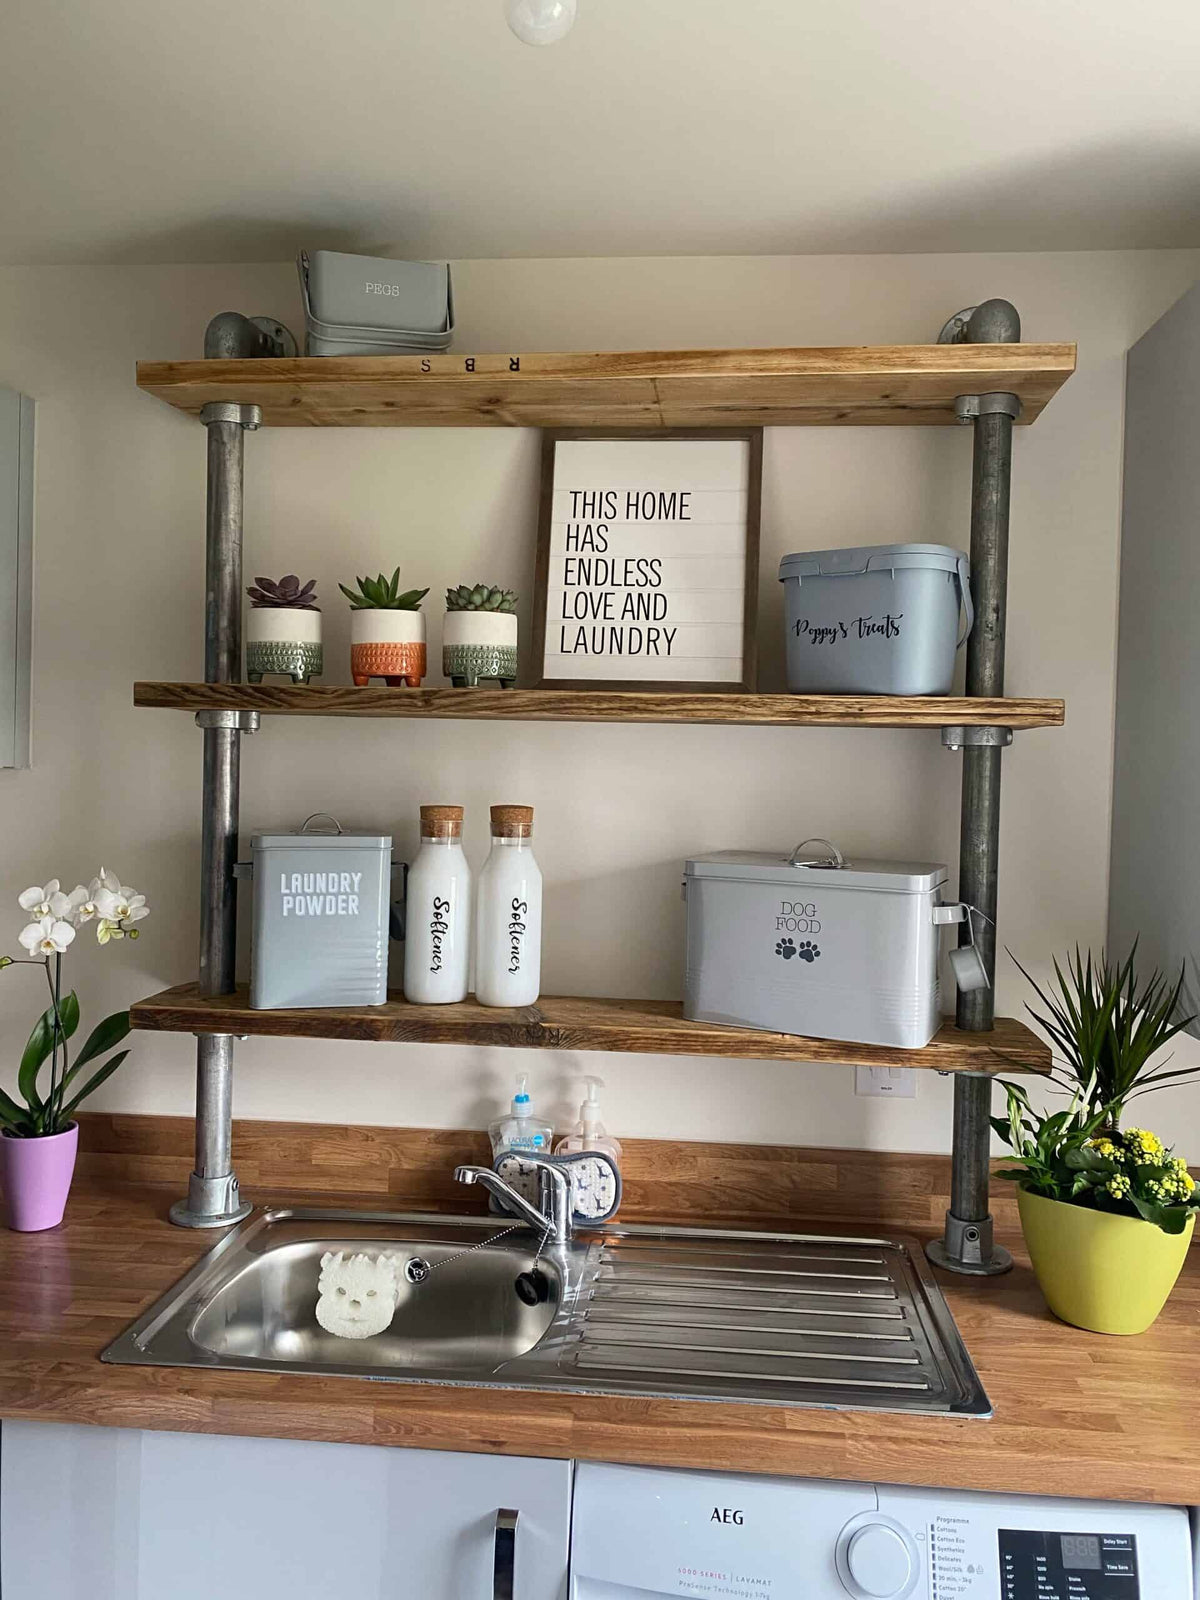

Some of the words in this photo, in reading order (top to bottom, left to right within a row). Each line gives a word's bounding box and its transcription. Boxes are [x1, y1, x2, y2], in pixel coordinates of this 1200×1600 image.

[365, 282, 400, 297] PEGS
[569, 490, 618, 520] THIS
[625, 491, 692, 521] HOME
[565, 523, 609, 553] HAS
[563, 557, 662, 588] ENDLESS
[562, 590, 616, 620] LOVE
[620, 592, 668, 621] AND
[560, 625, 678, 656] LAUNDRY
[792, 618, 848, 645] Poppy's
[280, 872, 362, 894] LAUNDRY
[282, 895, 359, 917] POWDER
[780, 901, 818, 918] DOG
[430, 896, 450, 974] Softener
[508, 897, 528, 975] Softener
[775, 916, 822, 934] FOOD
[710, 1507, 744, 1526] AEG
[936, 1516, 970, 1524] Programme
[679, 1579, 711, 1590] ProSense
[714, 1585, 753, 1599] Technology
[700, 1571, 727, 1580] SERIES
[735, 1575, 772, 1586] LAVAMAT
